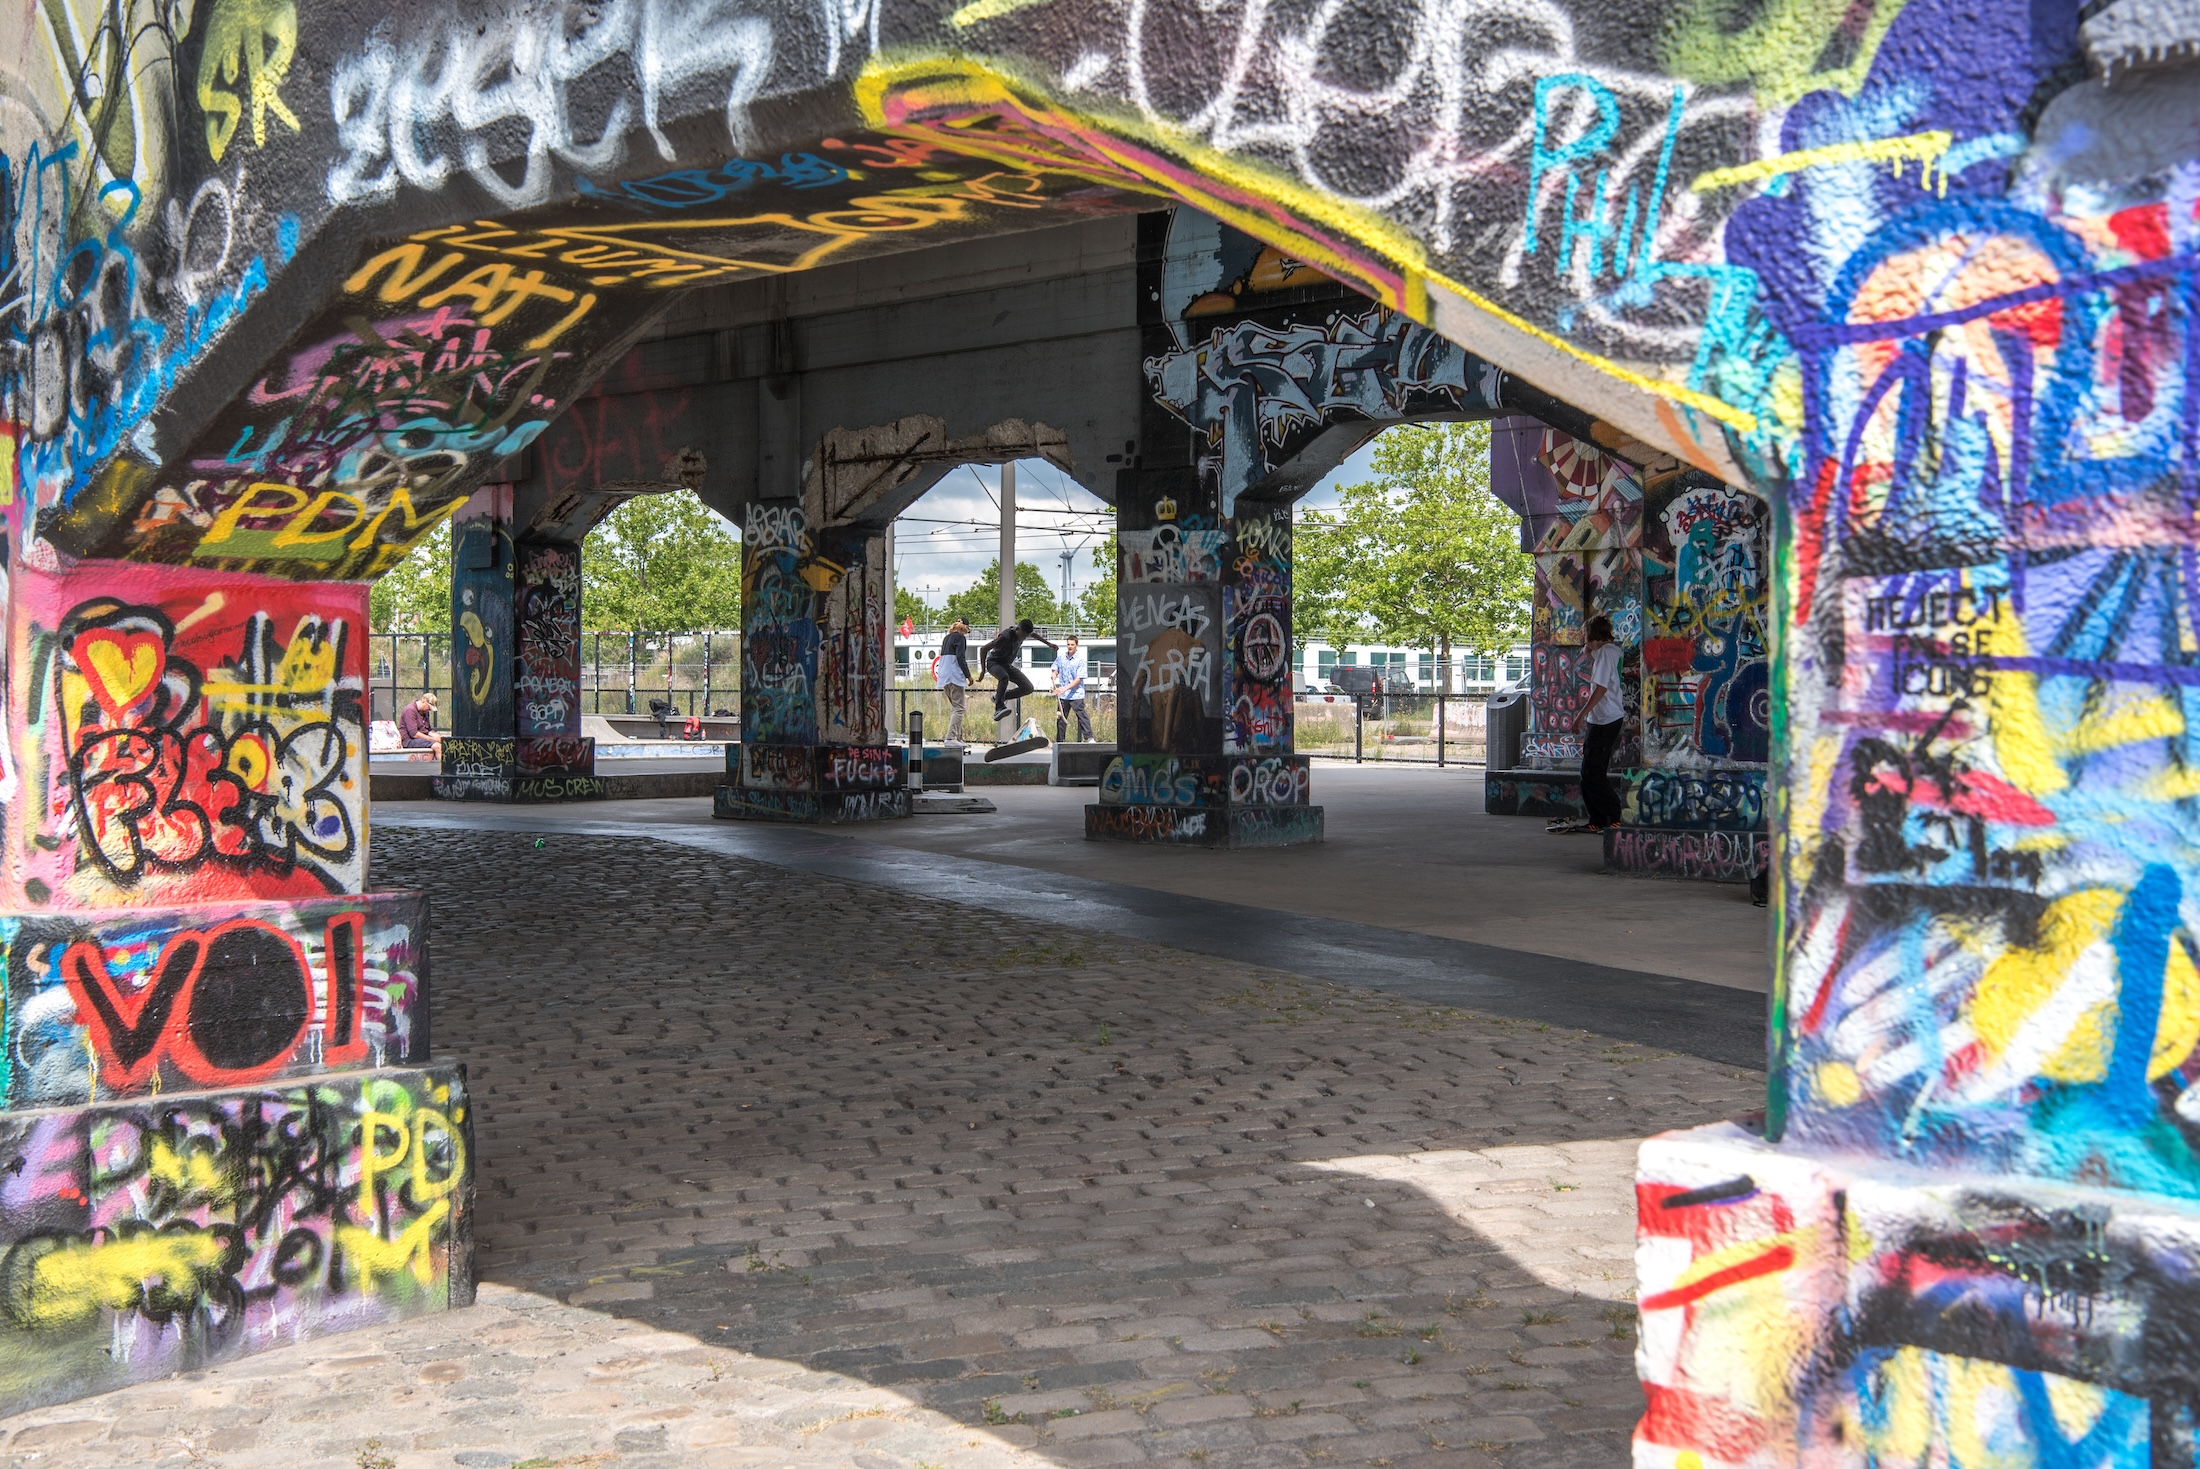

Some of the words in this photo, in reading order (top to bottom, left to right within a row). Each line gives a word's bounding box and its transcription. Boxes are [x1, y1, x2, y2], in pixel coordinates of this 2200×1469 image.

[1119, 594, 1210, 639] VENGAS
[516, 780, 565, 797] MUS
[566, 779, 606, 796] CREW
[834, 758, 880, 788] FUCK
[1230, 765, 1309, 804] DROP
